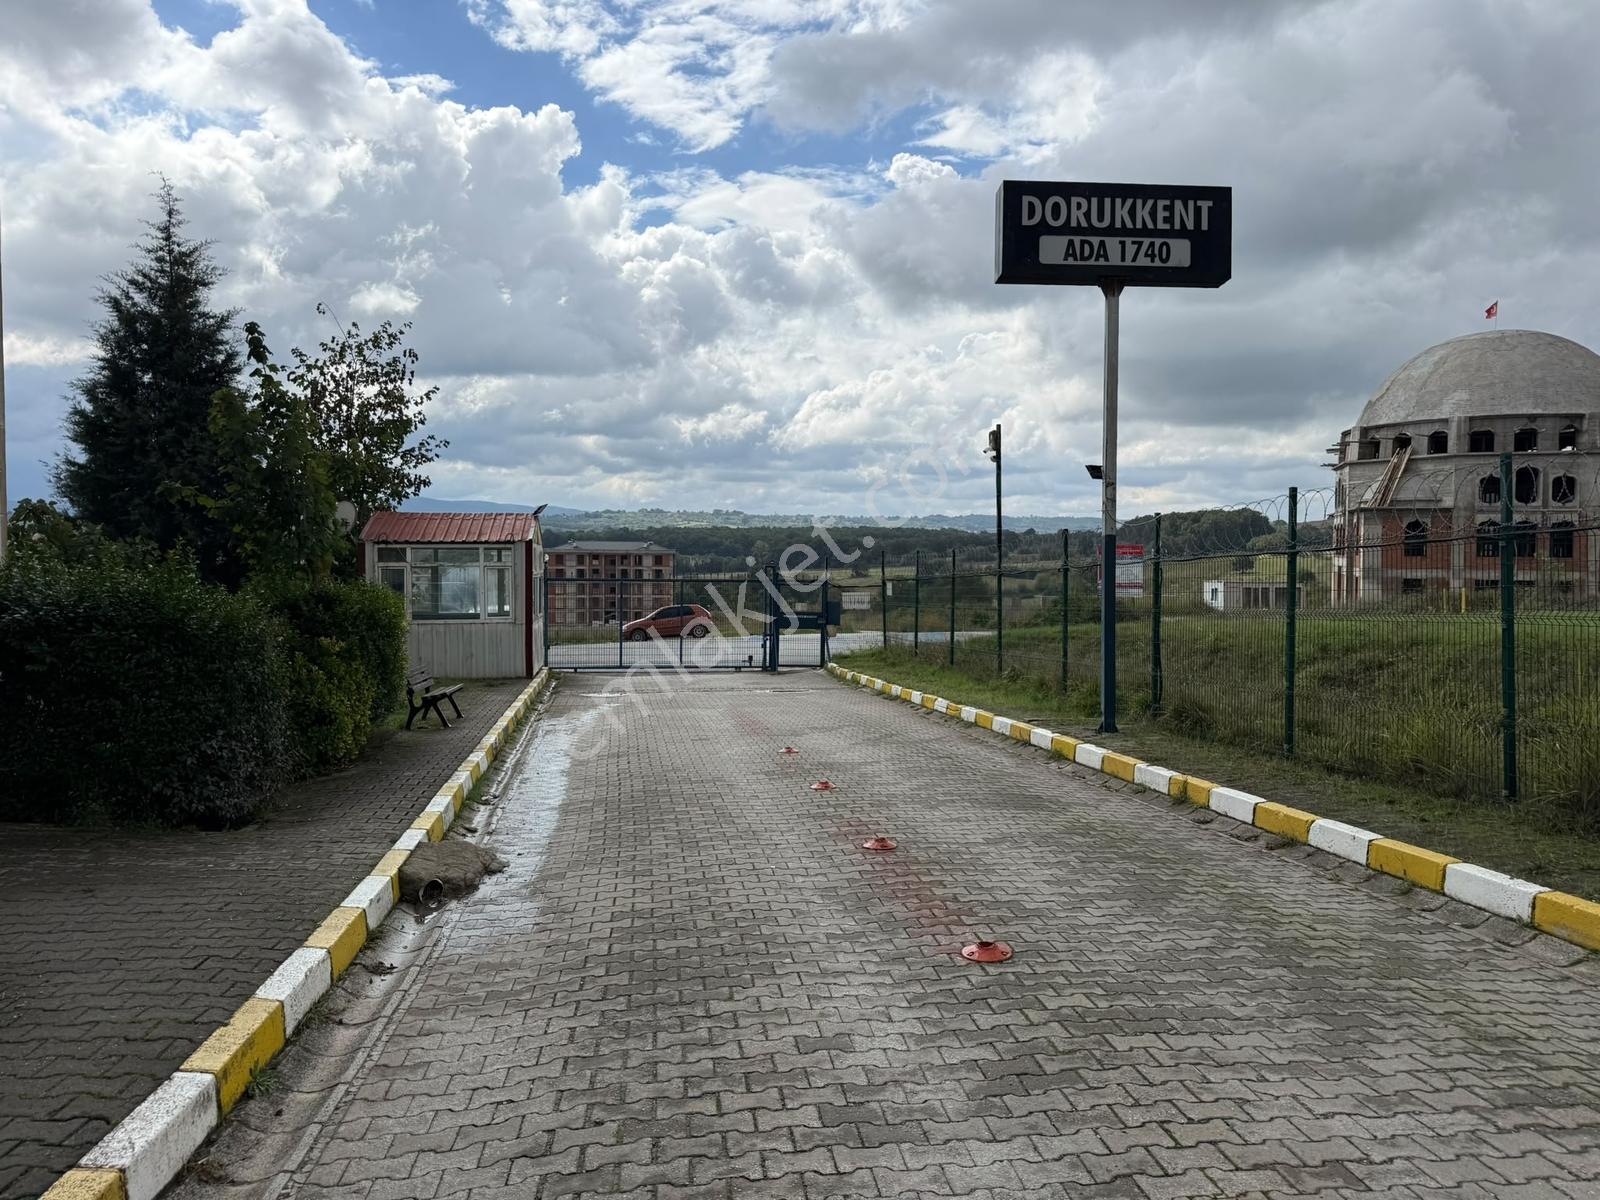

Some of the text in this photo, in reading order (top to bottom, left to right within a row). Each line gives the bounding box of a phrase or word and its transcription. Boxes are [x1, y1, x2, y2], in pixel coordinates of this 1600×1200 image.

[1022, 195, 1213, 230] DORUKKENT
[1063, 239, 1171, 264] ADA 1740
